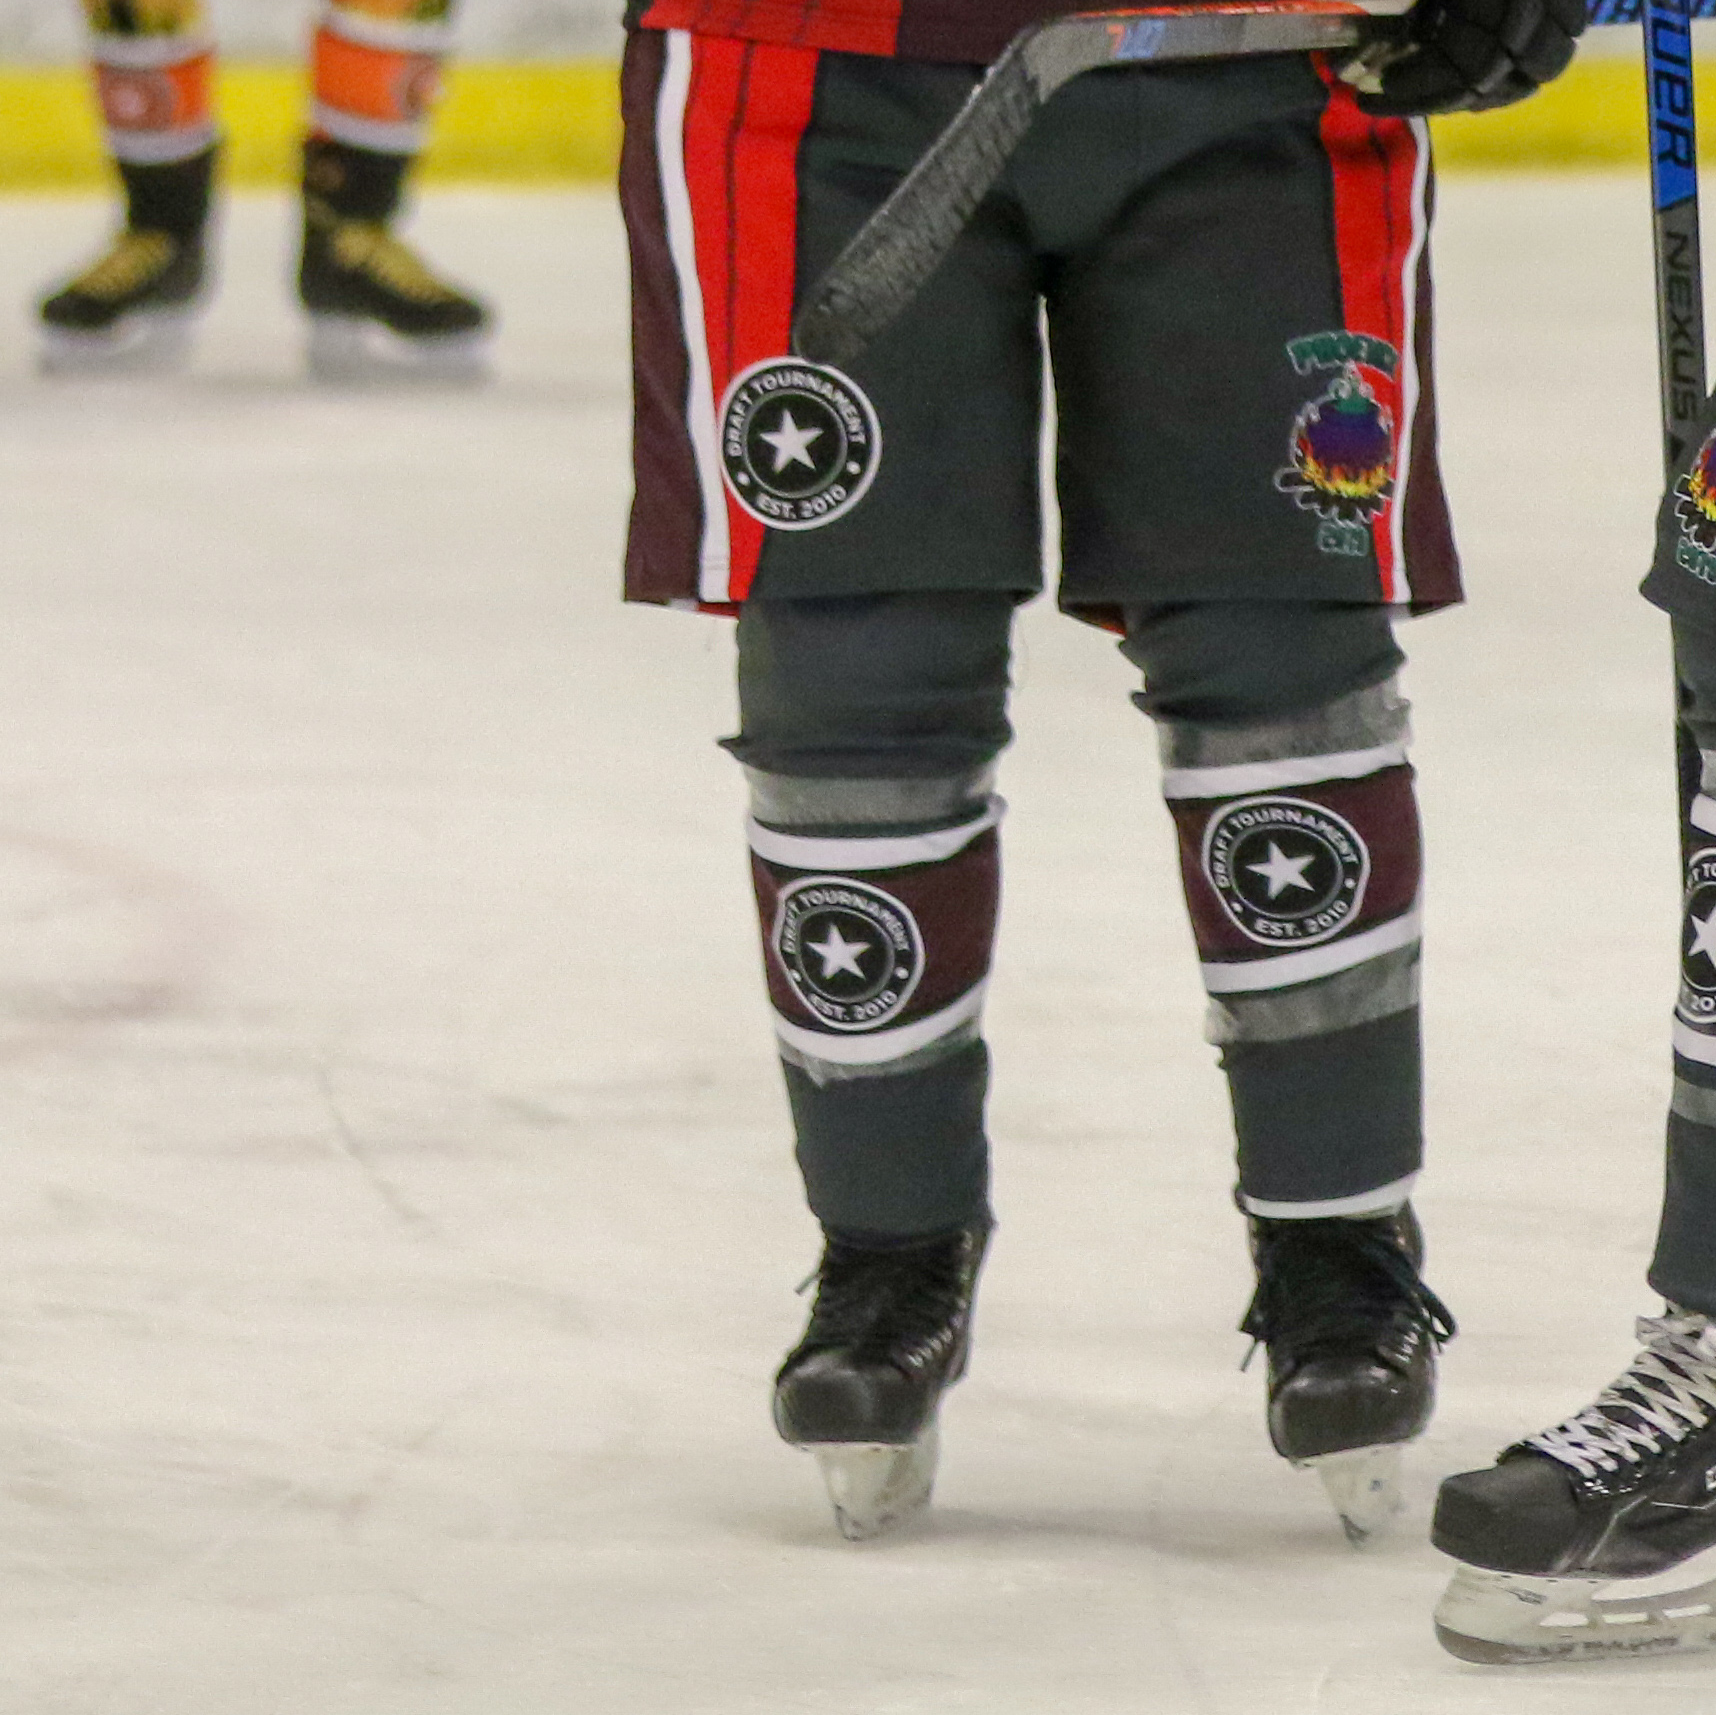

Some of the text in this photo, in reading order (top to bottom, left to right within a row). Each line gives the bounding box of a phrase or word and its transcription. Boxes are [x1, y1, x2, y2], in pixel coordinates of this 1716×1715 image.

[1664, 227, 1698, 423] NEXUS
[750, 370, 867, 445] TOURNAMENT
[799, 483, 847, 519] 2010
[1228, 807, 1360, 865] TOURNAMENT
[797, 889, 911, 951] TOURNAMENT
[1303, 900, 1349, 934] 2010
